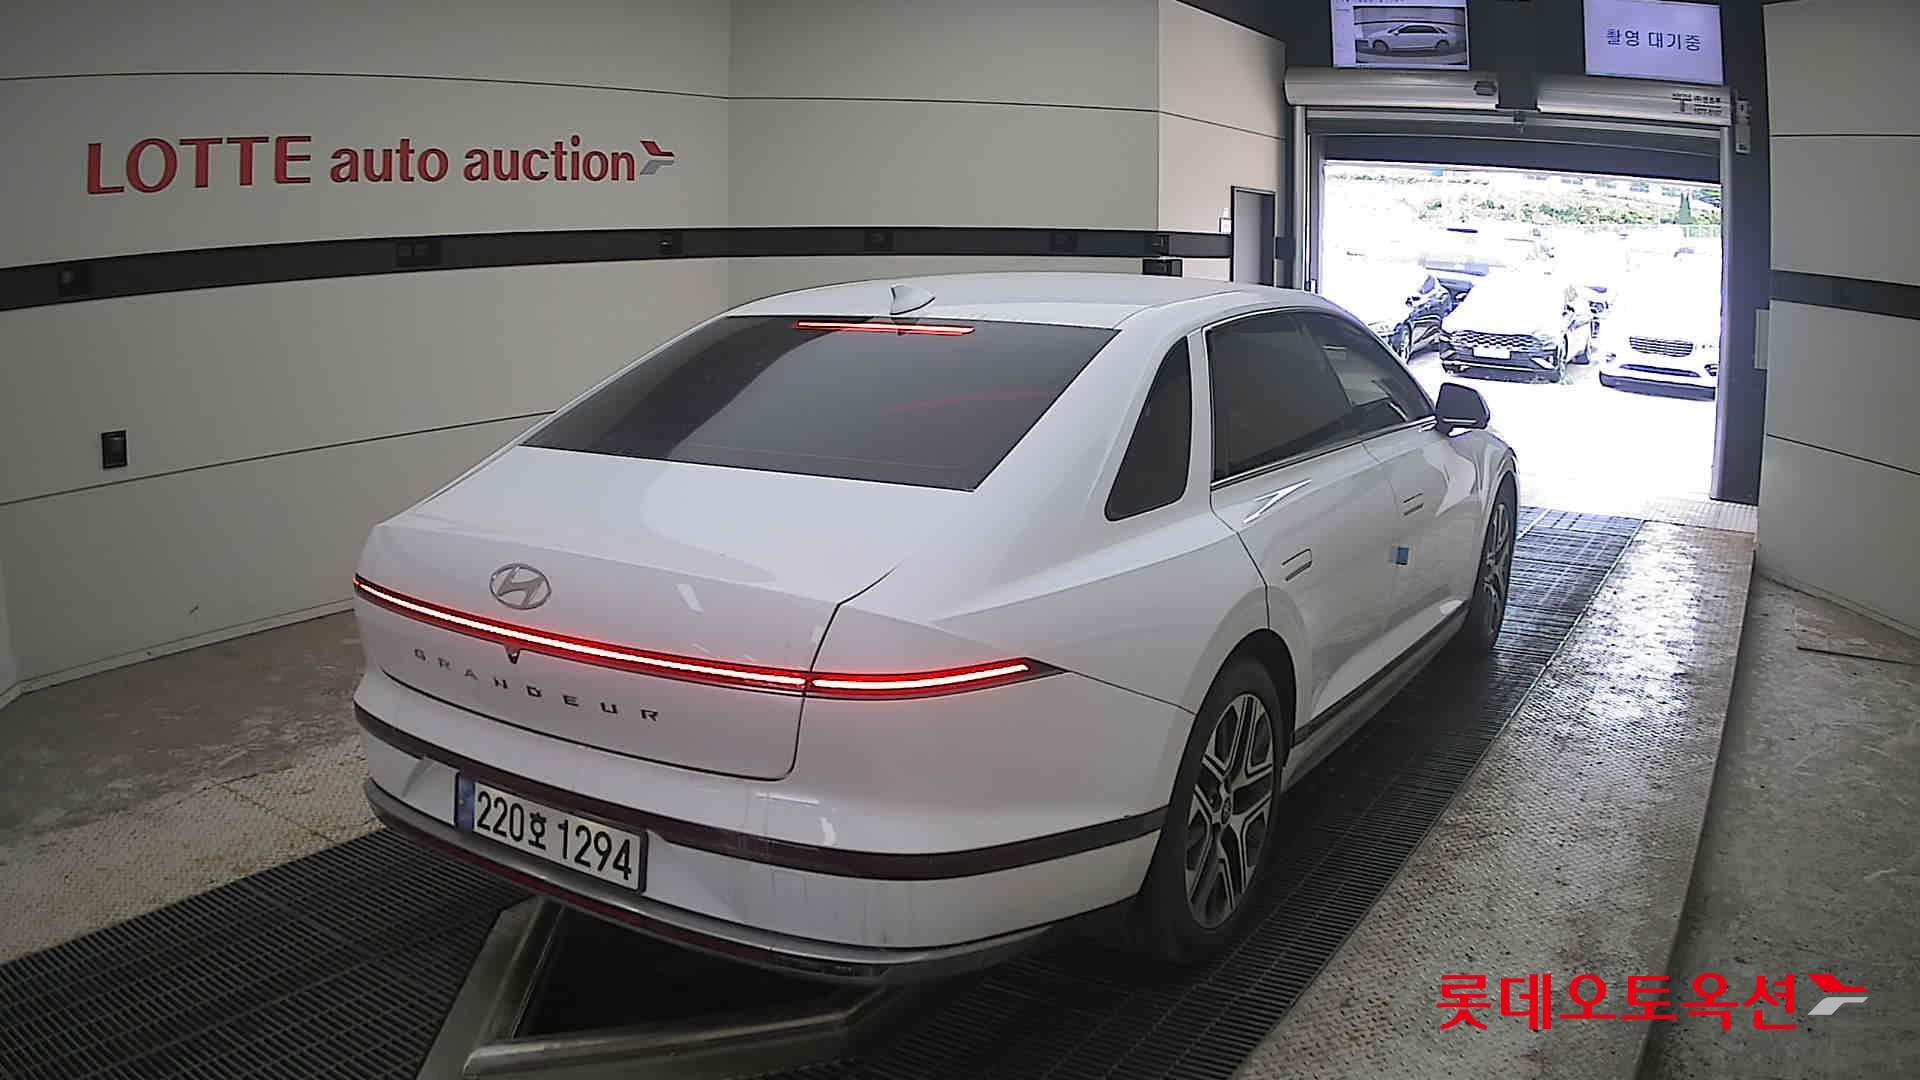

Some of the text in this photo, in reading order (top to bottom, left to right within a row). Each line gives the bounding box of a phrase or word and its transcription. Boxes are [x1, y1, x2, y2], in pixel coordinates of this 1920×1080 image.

[1648, 32, 1701, 52] 대기중
[87, 134, 635, 194] LOTTE auto auction
[414, 648, 659, 721] GRANDEUR
[477, 791, 632, 881] 220호 1294
